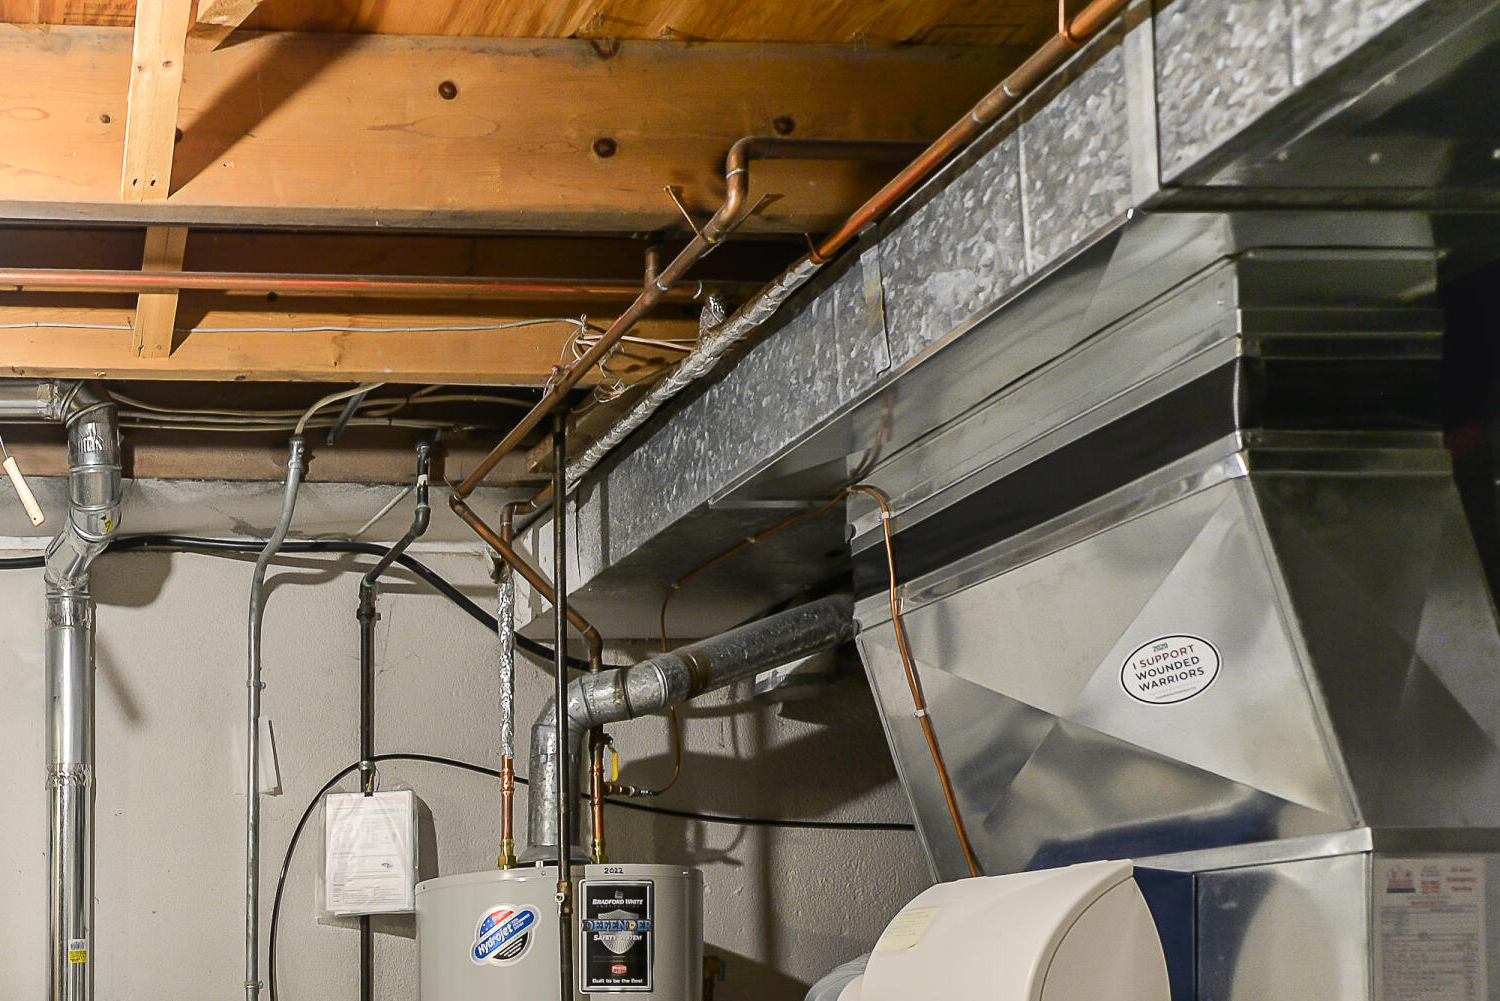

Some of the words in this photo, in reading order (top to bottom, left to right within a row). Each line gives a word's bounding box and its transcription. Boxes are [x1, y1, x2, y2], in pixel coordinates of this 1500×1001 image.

[1139, 644, 1194, 668] SUPPORT
[1136, 656, 1200, 681] WOUNDED
[1139, 667, 1205, 692] WARRIORS
[582, 919, 652, 931] DEFENDER
